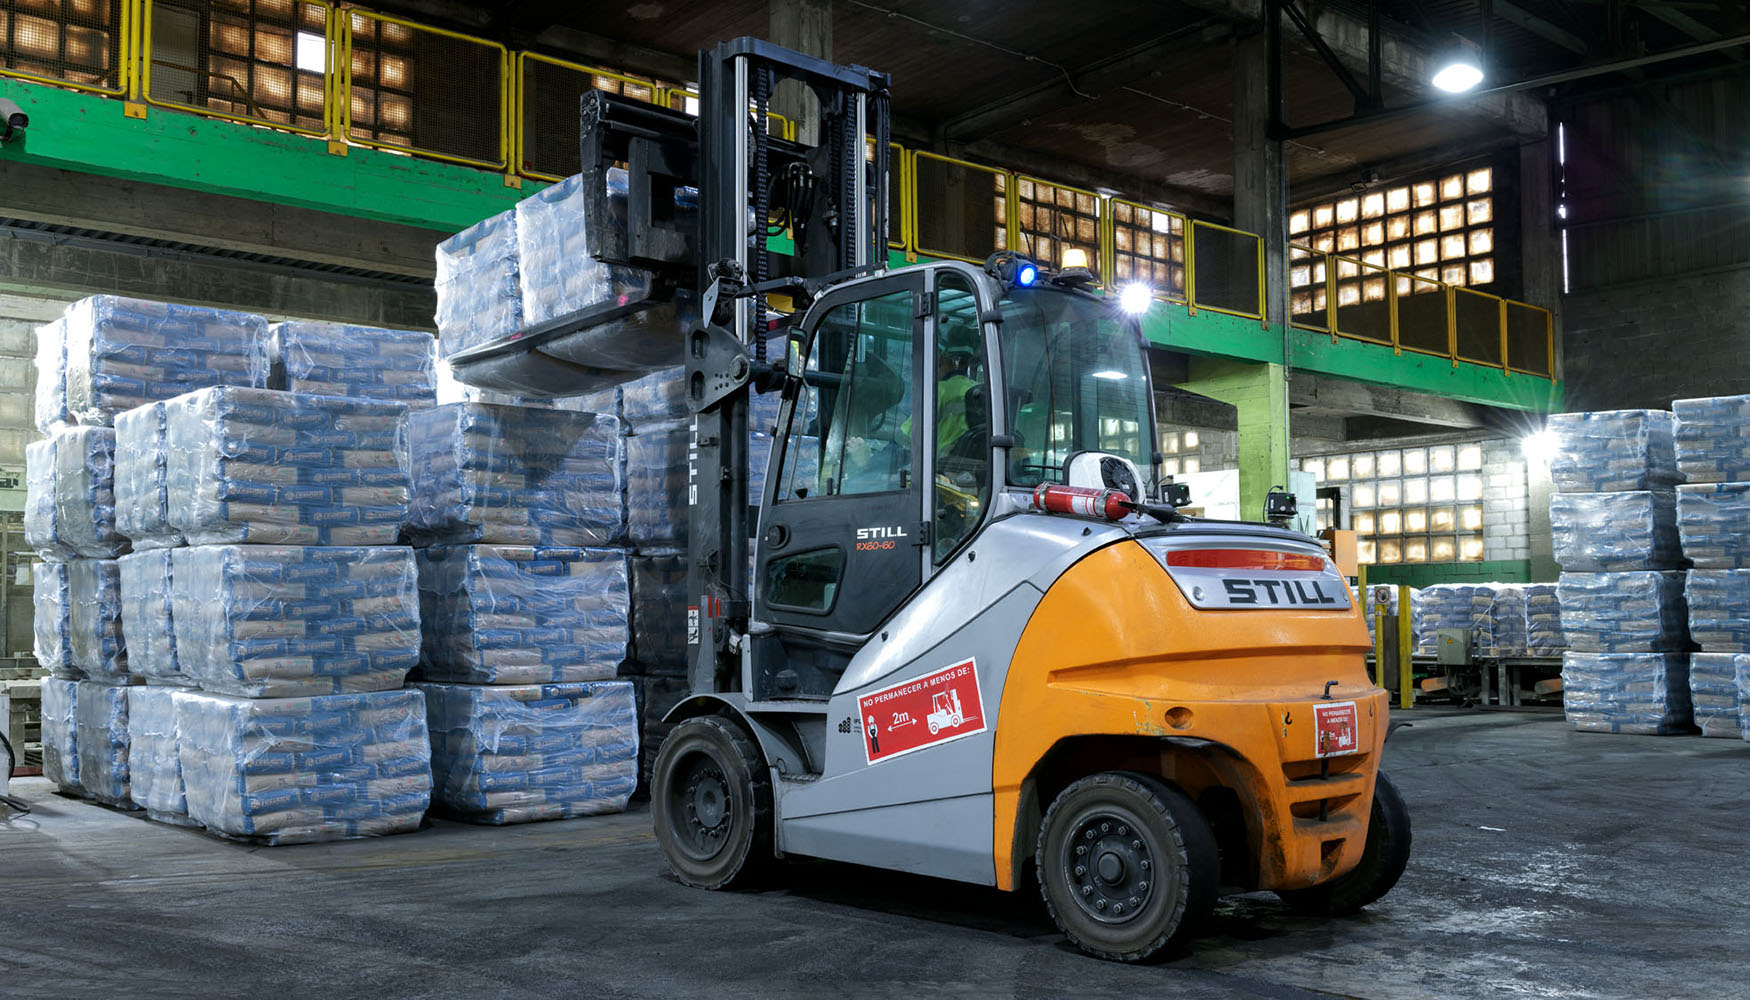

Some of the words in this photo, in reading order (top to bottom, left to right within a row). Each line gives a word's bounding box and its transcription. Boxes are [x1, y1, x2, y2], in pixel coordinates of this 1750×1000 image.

[689, 414, 698, 505] STILL
[856, 526, 908, 539] STILL
[1222, 579, 1336, 604] STILL
[863, 699, 874, 708] NO
[874, 683, 922, 704] PERMANECER
[923, 681, 929, 689] A
[930, 671, 956, 686] MENOS
[957, 666, 971, 677] DE:
[892, 712, 909, 724] 2m
